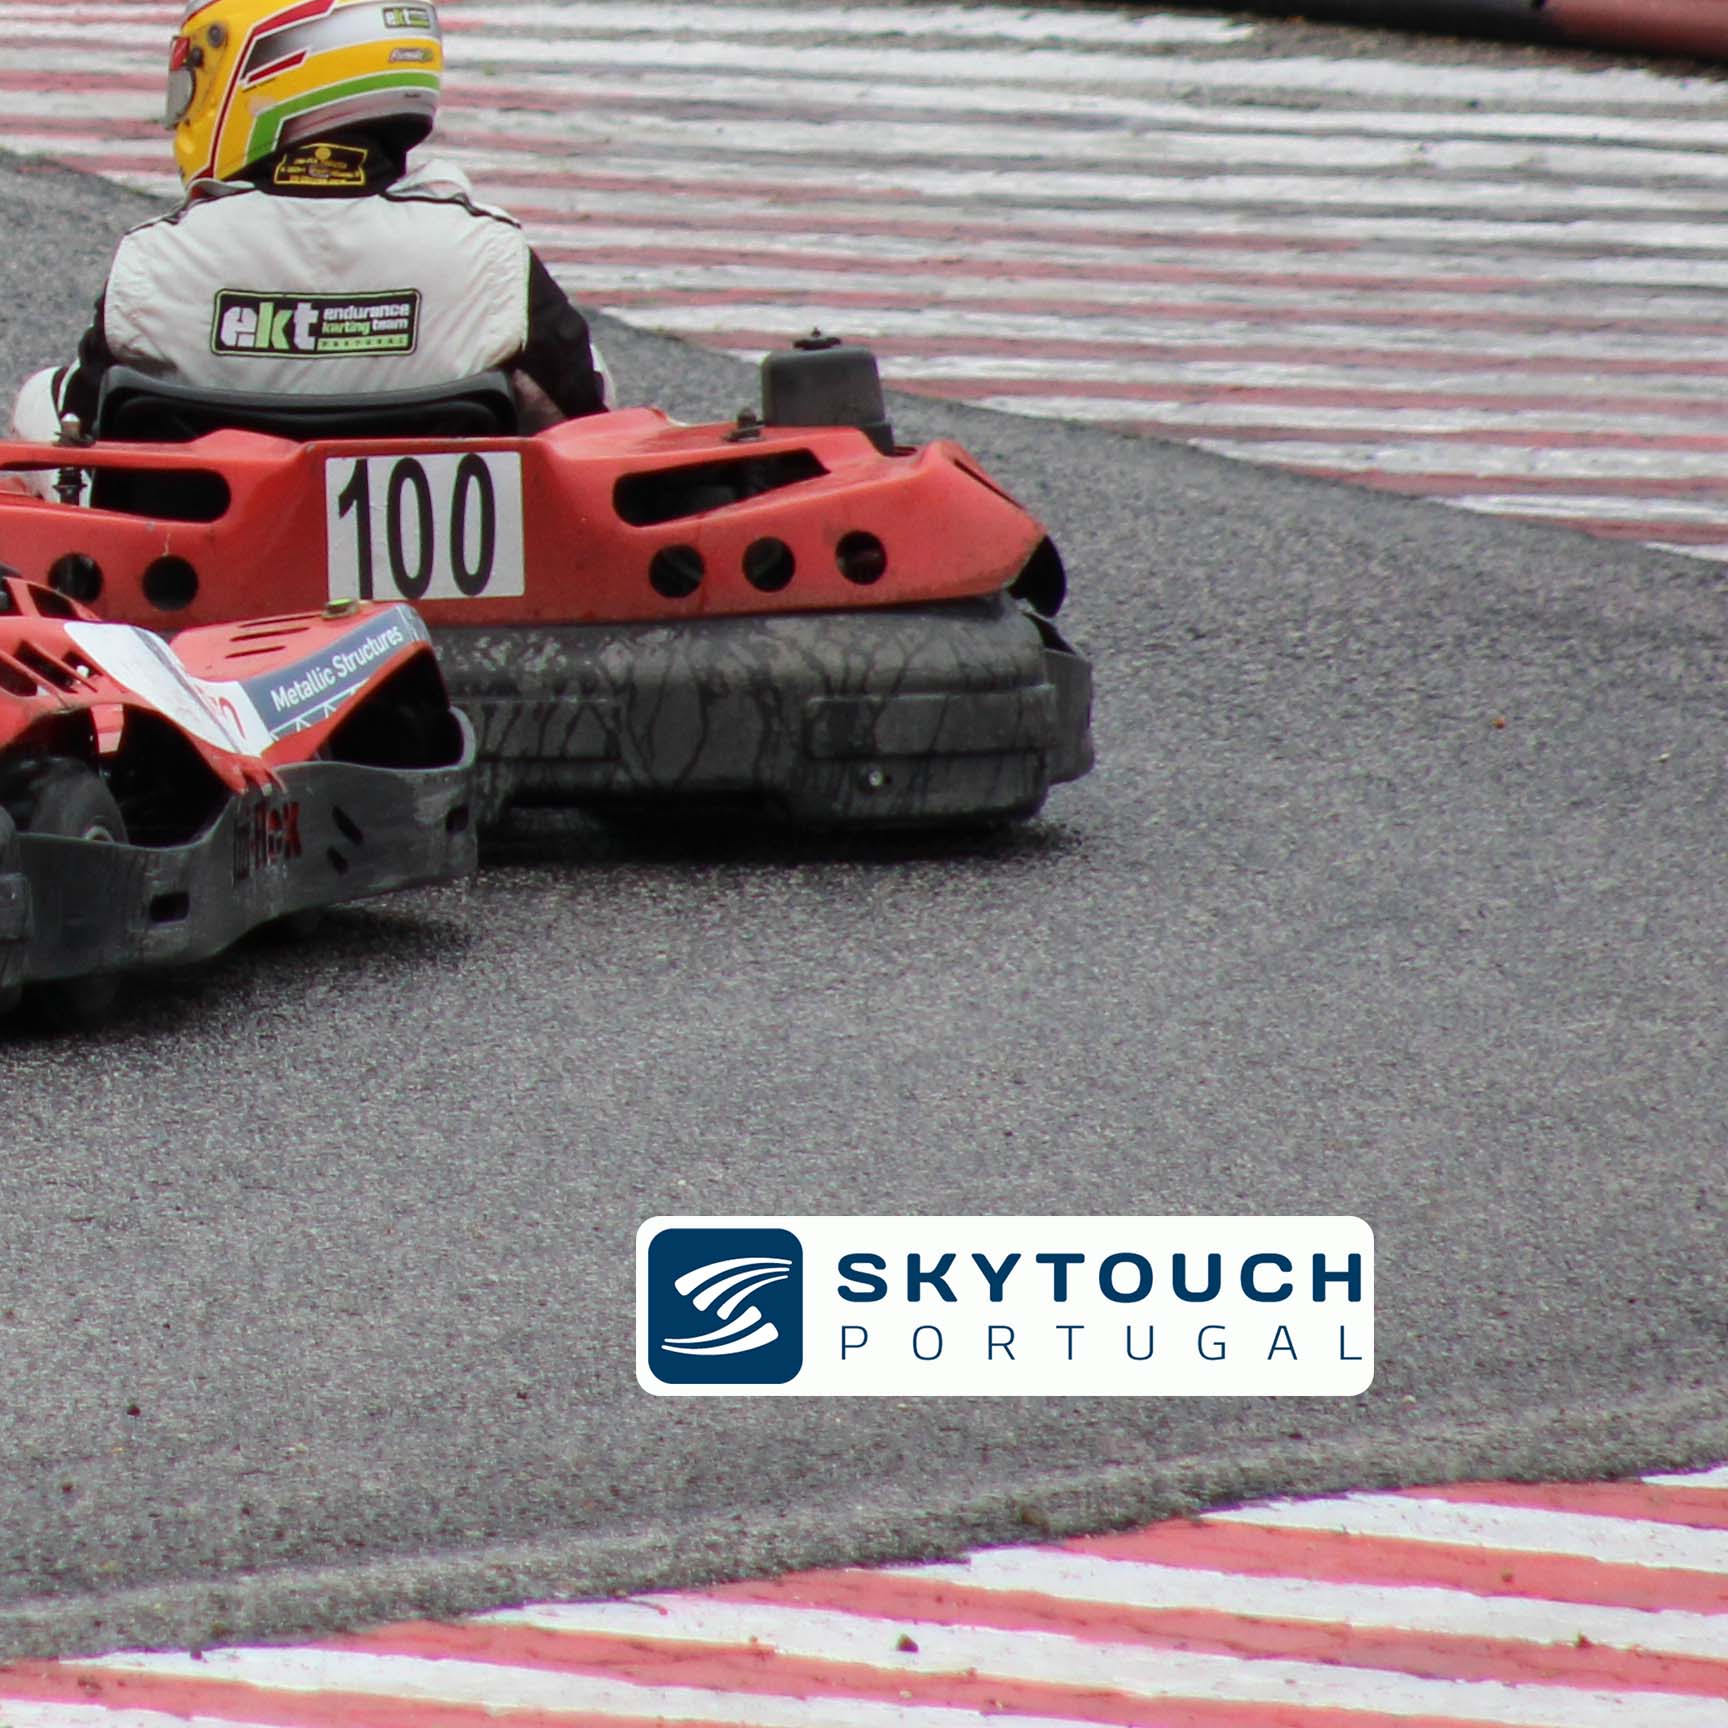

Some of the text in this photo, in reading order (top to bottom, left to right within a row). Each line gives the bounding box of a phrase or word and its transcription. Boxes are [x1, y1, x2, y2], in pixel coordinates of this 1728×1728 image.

[220, 301, 319, 351] ekt
[323, 304, 410, 321] endurance
[338, 453, 496, 600] 100
[270, 626, 404, 712] Metallic Structures
